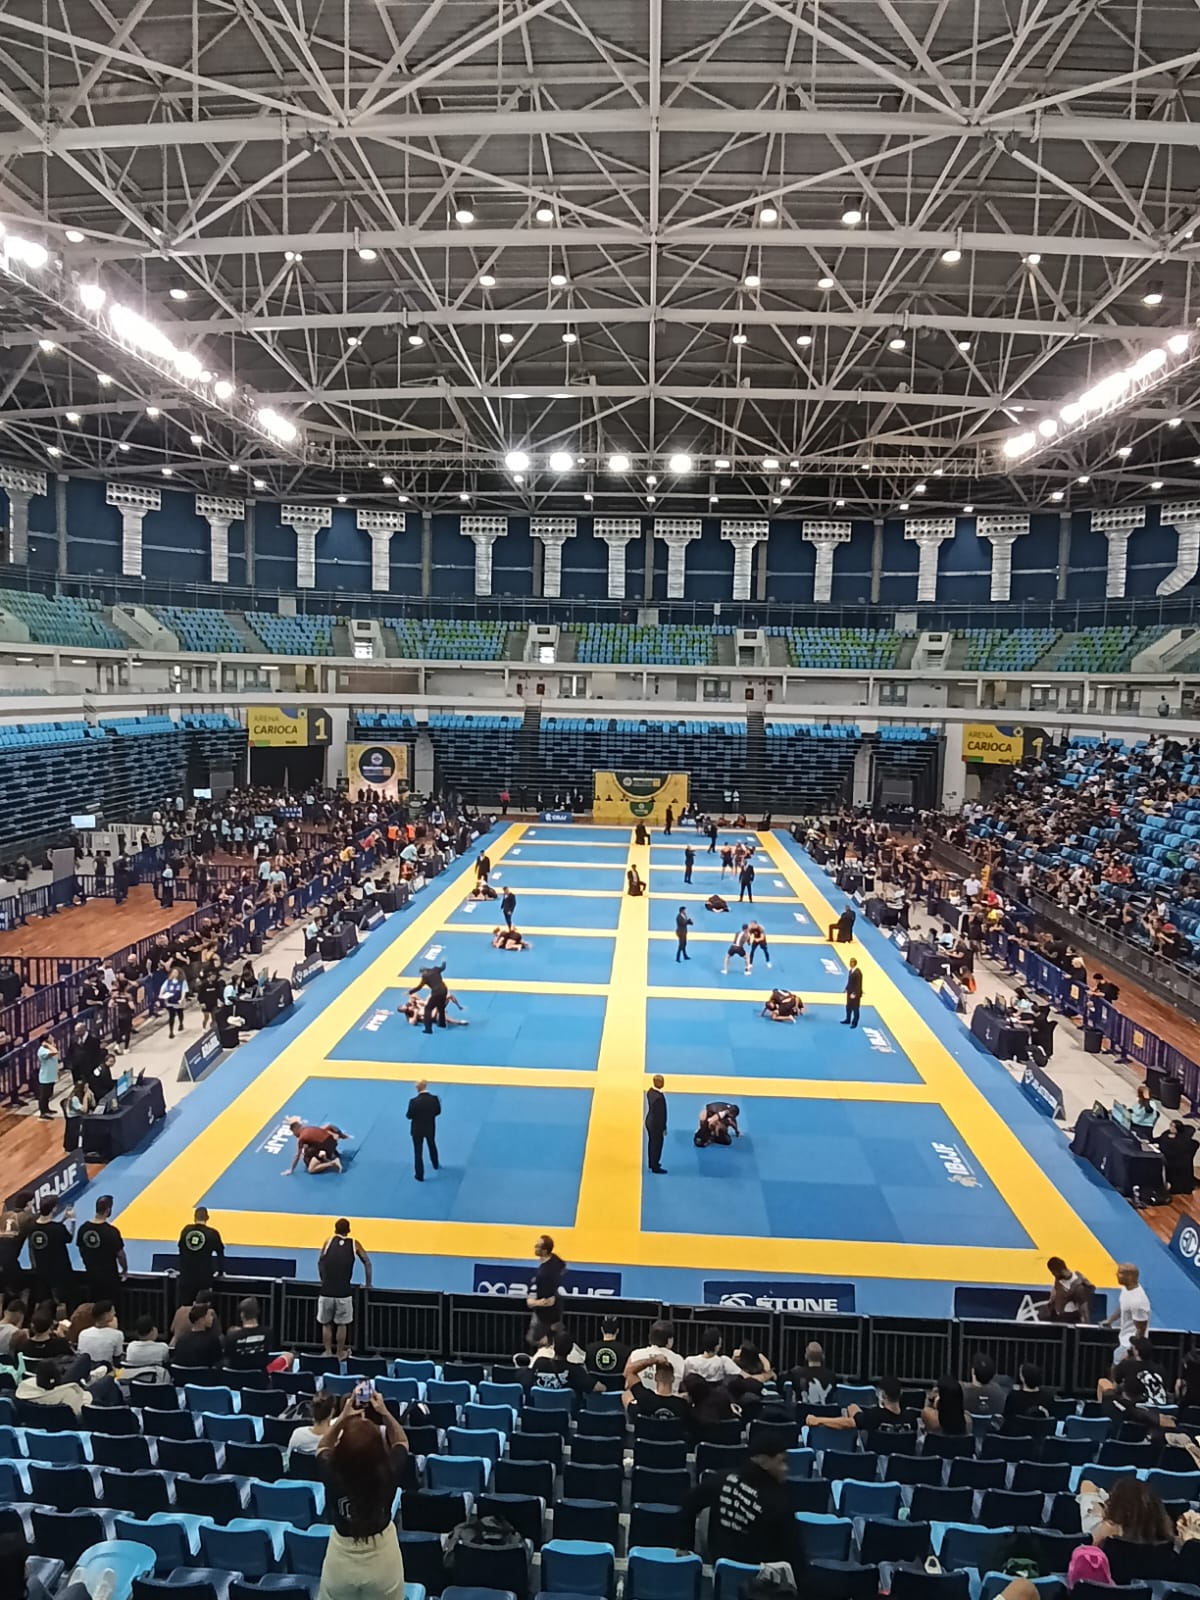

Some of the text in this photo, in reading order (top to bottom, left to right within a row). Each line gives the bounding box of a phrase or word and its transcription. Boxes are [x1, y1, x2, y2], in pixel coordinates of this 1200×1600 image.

[253, 725, 298, 735] CARIOCA
[315, 717, 328, 740] 1
[968, 731, 993, 739] ARENA
[967, 741, 1012, 752] CARIOCA
[1032, 737, 1043, 759] 1
[931, 1142, 970, 1176] IBJJF
[756, 1296, 838, 1313] STONE
